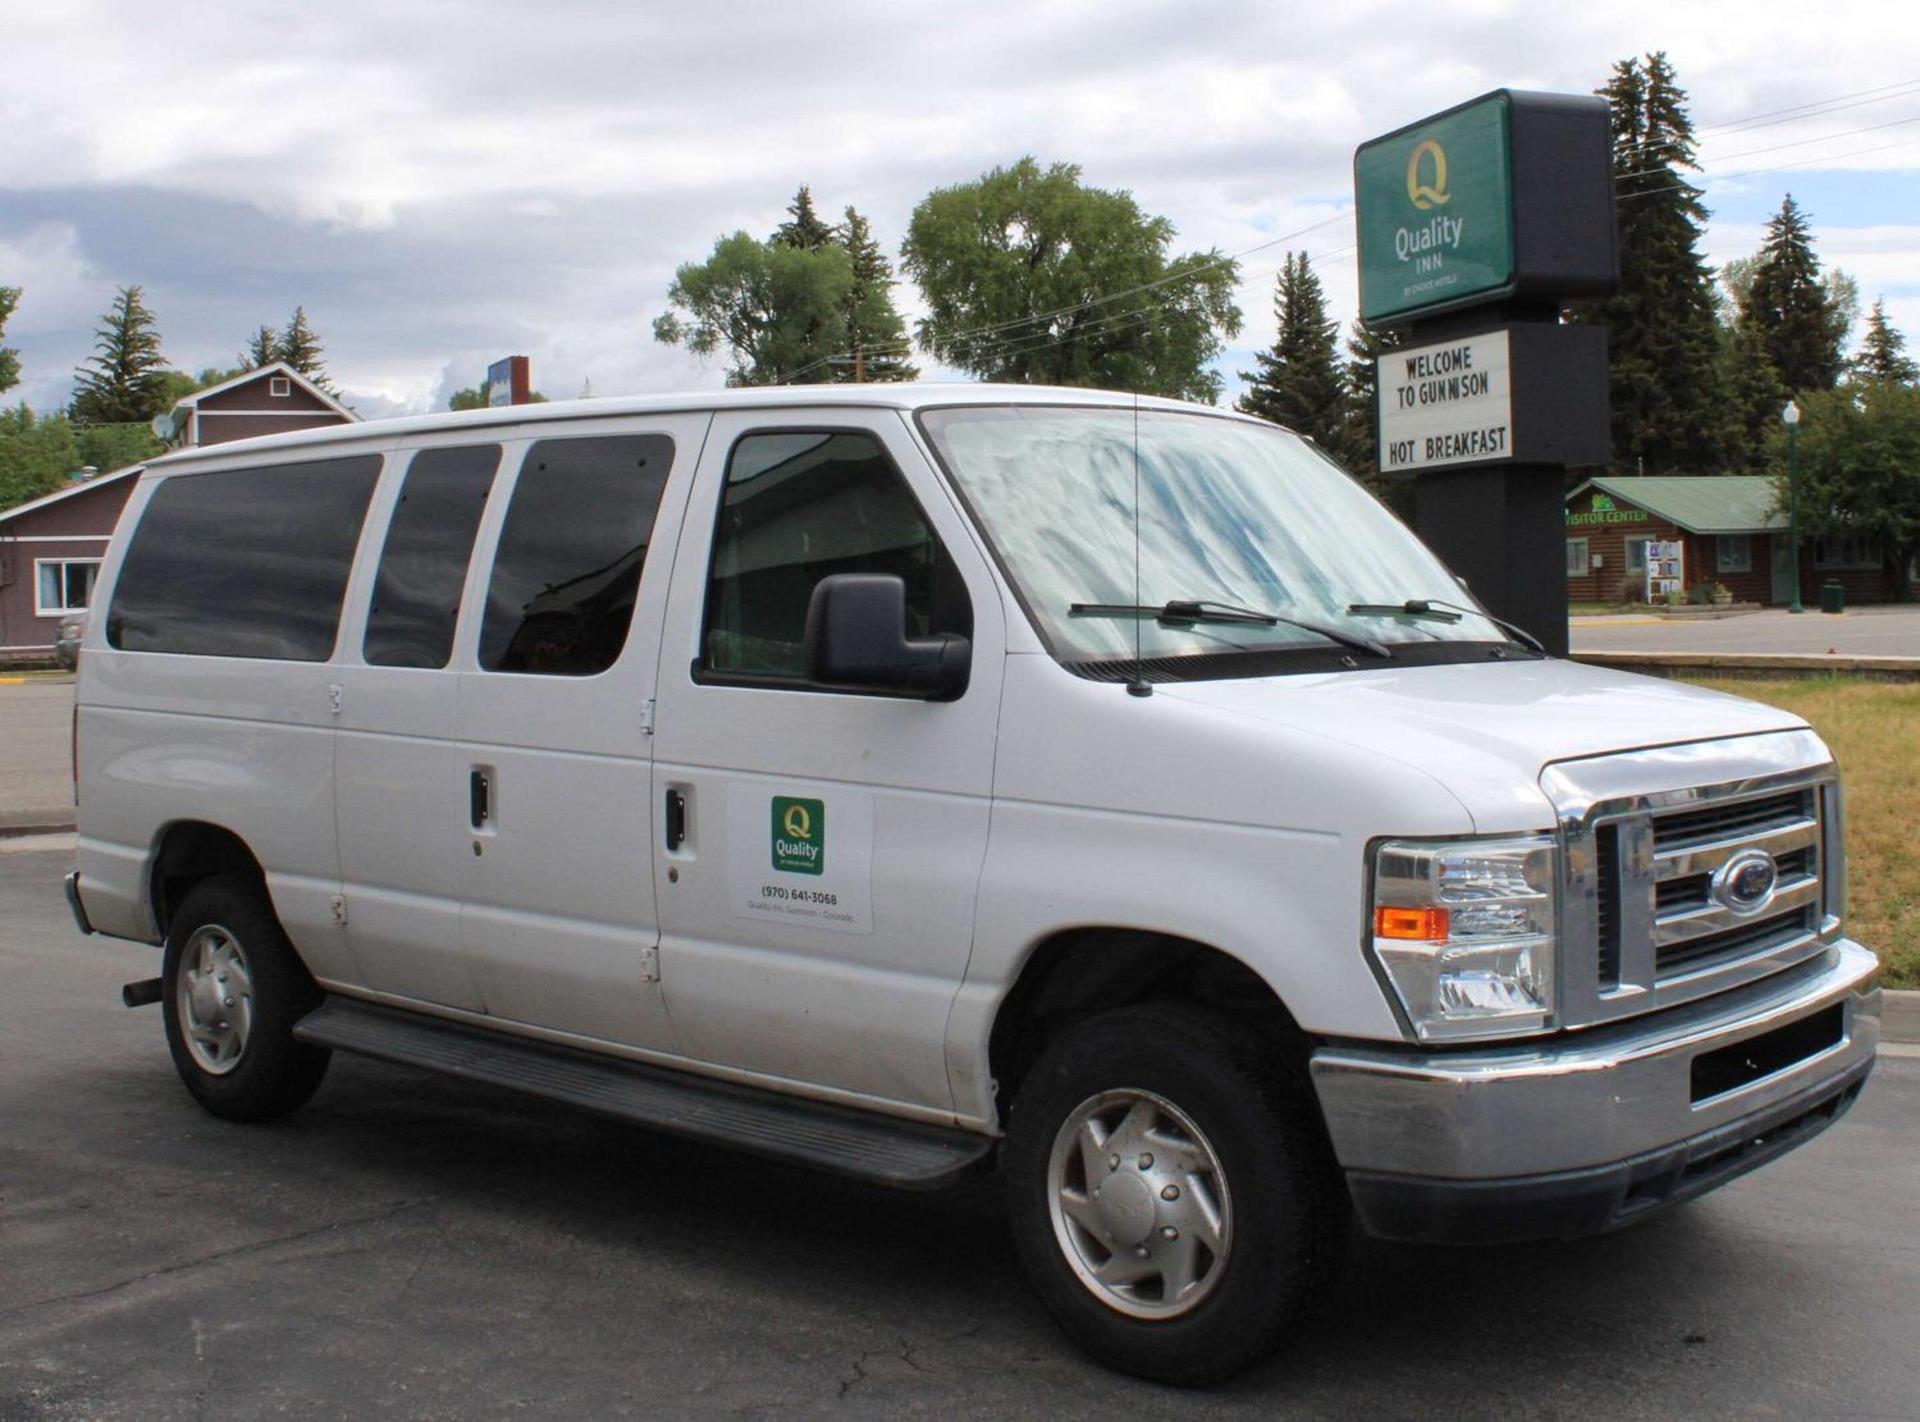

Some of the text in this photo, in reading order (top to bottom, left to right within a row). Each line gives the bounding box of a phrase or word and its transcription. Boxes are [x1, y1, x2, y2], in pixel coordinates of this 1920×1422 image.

[1407, 139, 1451, 210] Q
[1395, 216, 1463, 262] Quality
[1416, 252, 1442, 274] INN
[1406, 346, 1472, 380] WELCOME
[1397, 371, 1489, 409] TO GUNNISON
[1389, 426, 1506, 464] HOT BREAKFAST
[1606, 510, 1648, 523] CENTER
[784, 804, 811, 839] Q
[776, 839, 819, 860] Quality
[762, 886, 838, 906] (970) 641-3068
